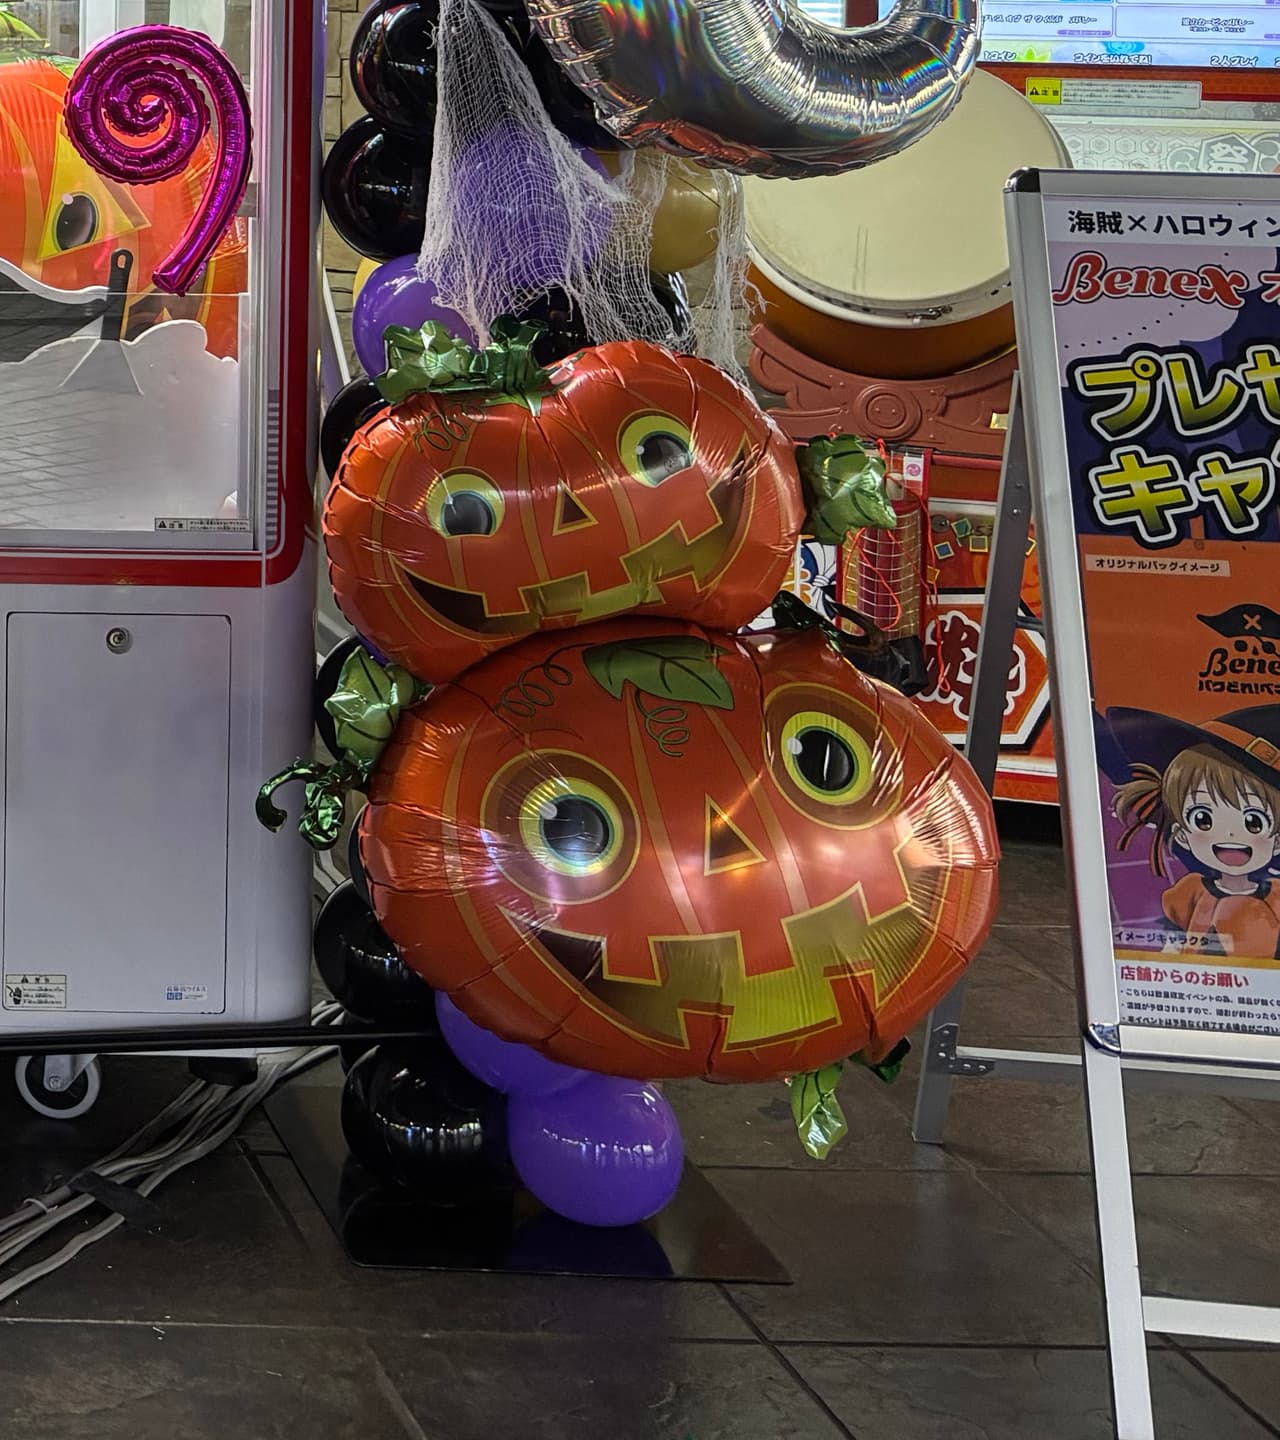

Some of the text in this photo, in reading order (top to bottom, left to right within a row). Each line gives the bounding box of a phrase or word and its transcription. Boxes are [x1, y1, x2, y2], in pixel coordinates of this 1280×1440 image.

[1051, 250, 1248, 308] Benex
[1096, 559, 1220, 572] オリジナルバッグイメージ
[1120, 964, 1249, 988] 店舗からのお願い
